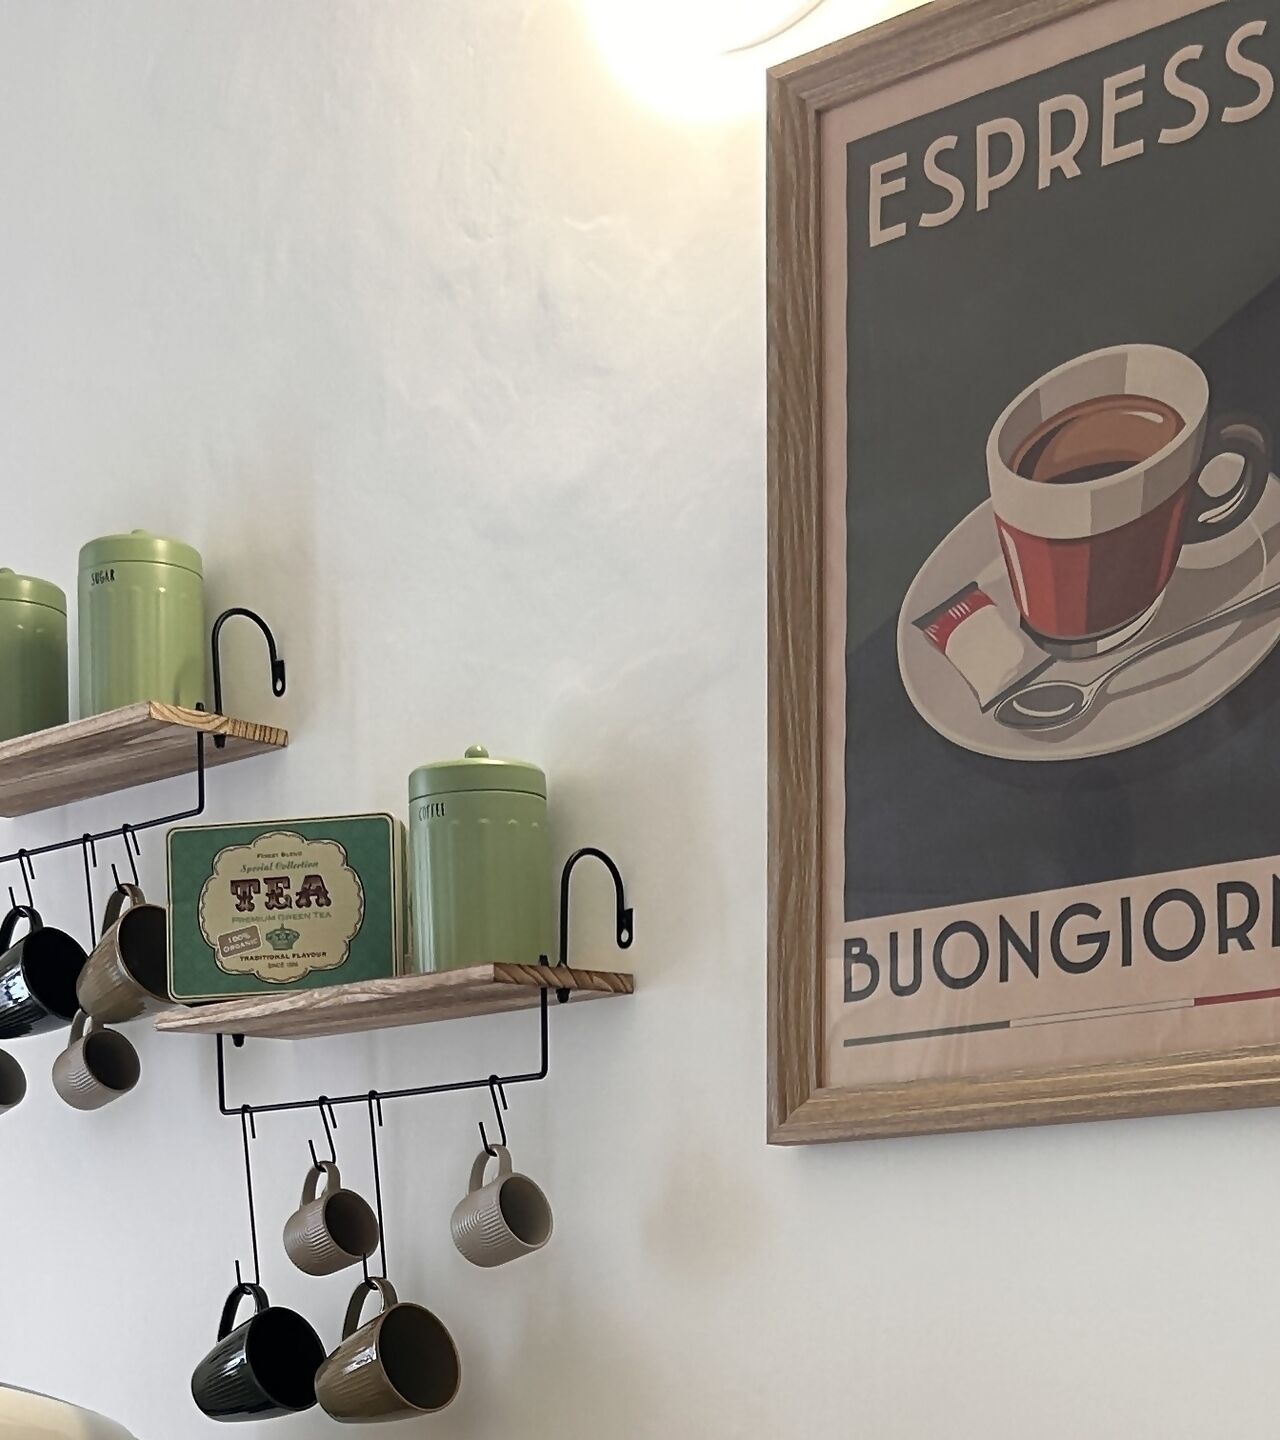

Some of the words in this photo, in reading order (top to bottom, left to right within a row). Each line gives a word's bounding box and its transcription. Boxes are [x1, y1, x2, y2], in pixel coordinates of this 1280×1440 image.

[91, 569, 115, 587] SUGAR
[240, 861, 274, 874] Special
[275, 860, 319, 871] Collection
[230, 874, 332, 913] TEA
[232, 914, 276, 924] PREMIUM
[278, 911, 312, 921] GREEN
[312, 911, 332, 919] TEA
[228, 931, 252, 944] 100%
[240, 953, 290, 962] TRADITIONAL
[292, 951, 327, 960] FLAVOUR
